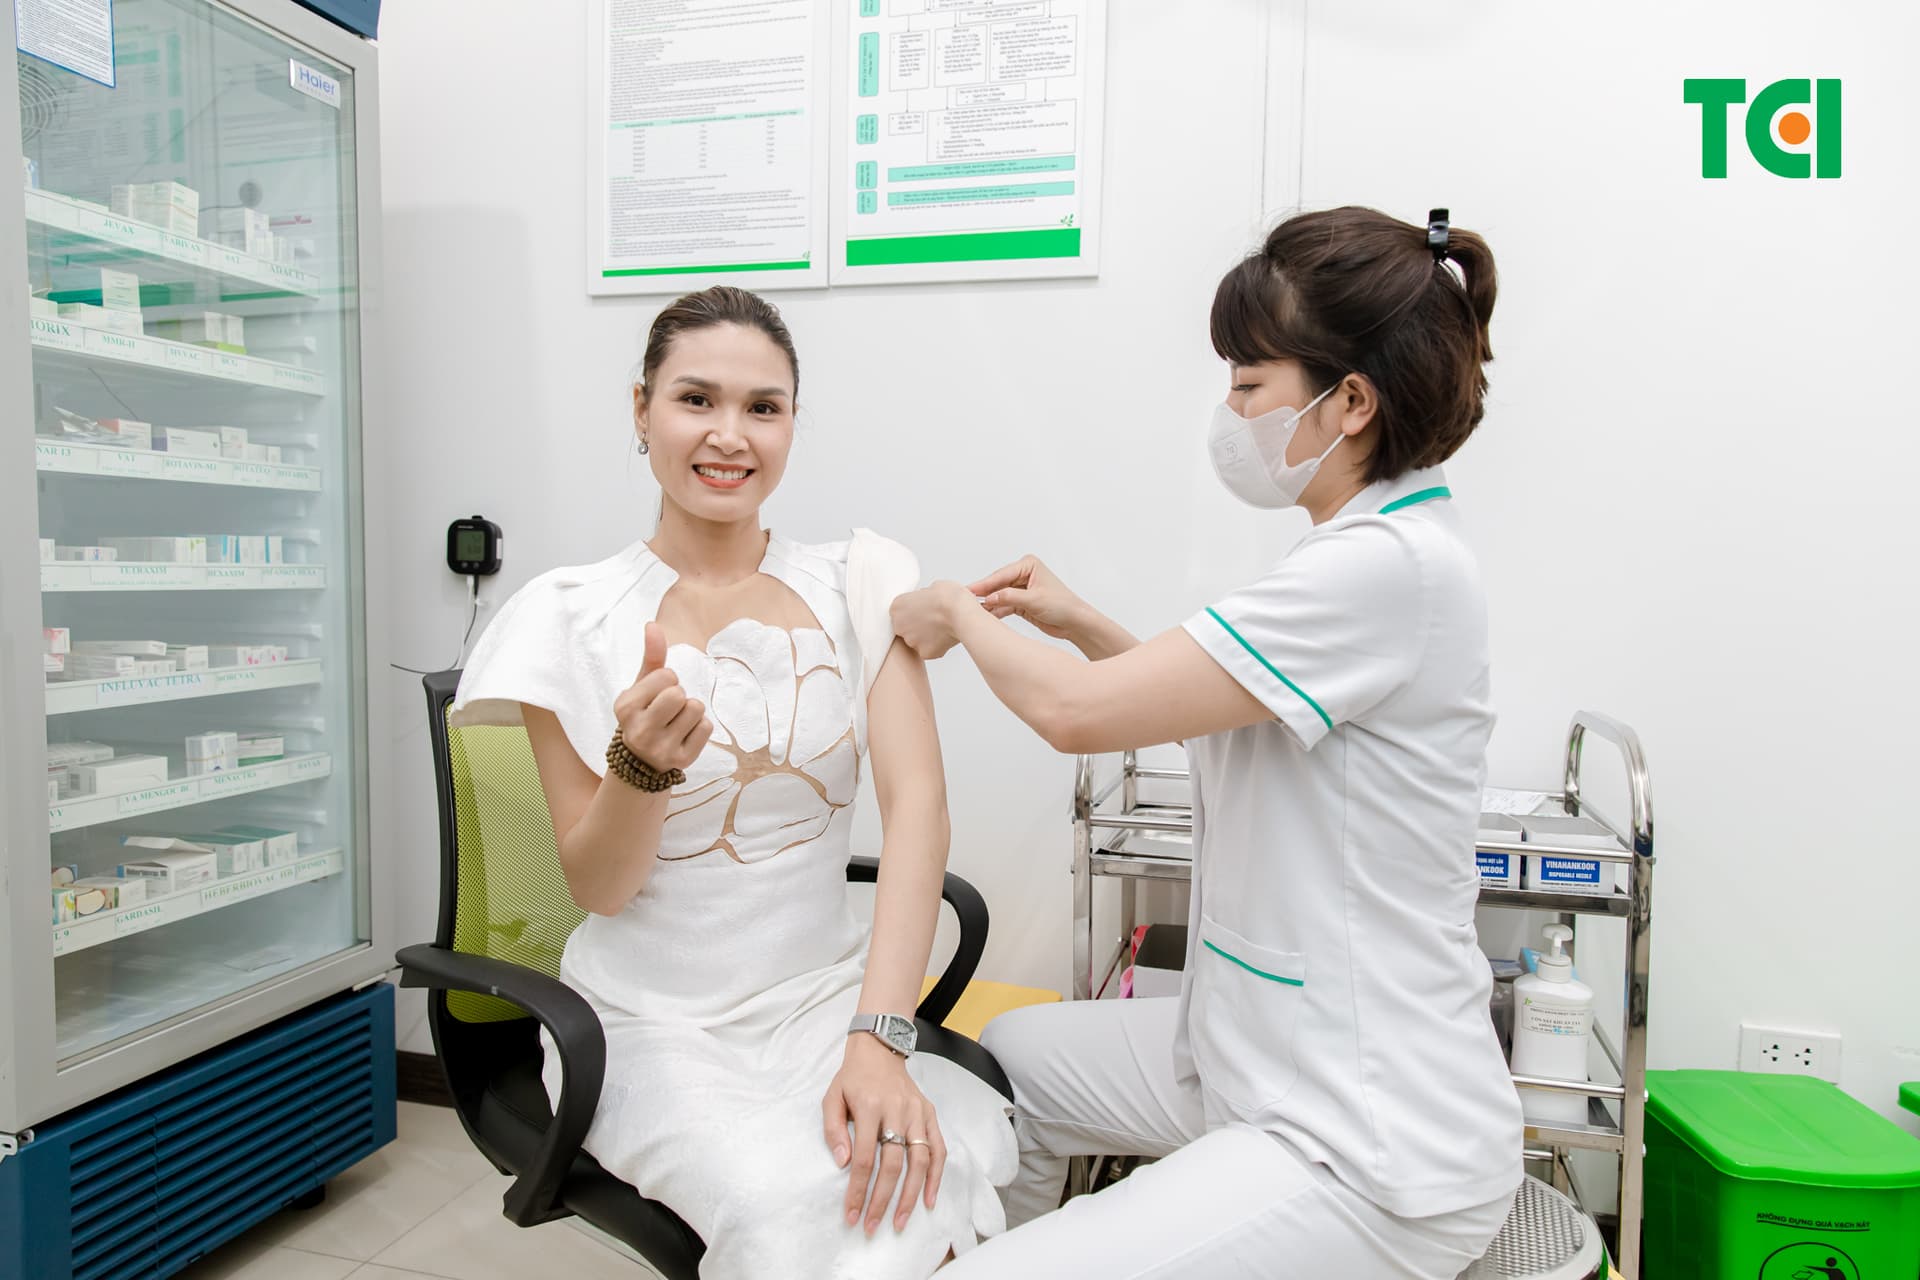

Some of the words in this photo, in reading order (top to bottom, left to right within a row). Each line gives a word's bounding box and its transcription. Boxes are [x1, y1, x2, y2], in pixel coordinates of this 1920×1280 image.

[300, 66, 335, 95] Haier
[104, 219, 135, 235] JEVAX
[61, 448, 71, 457] 13
[117, 452, 135, 463] VAT
[101, 678, 161, 693] INFLUVAC
[165, 674, 202, 687] TETRA
[1545, 860, 1596, 871] VINAHANKOOK
[116, 905, 162, 924] GARDASIL
[63, 929, 70, 937] 9
[1756, 1211, 1787, 1223] KHÔNG
